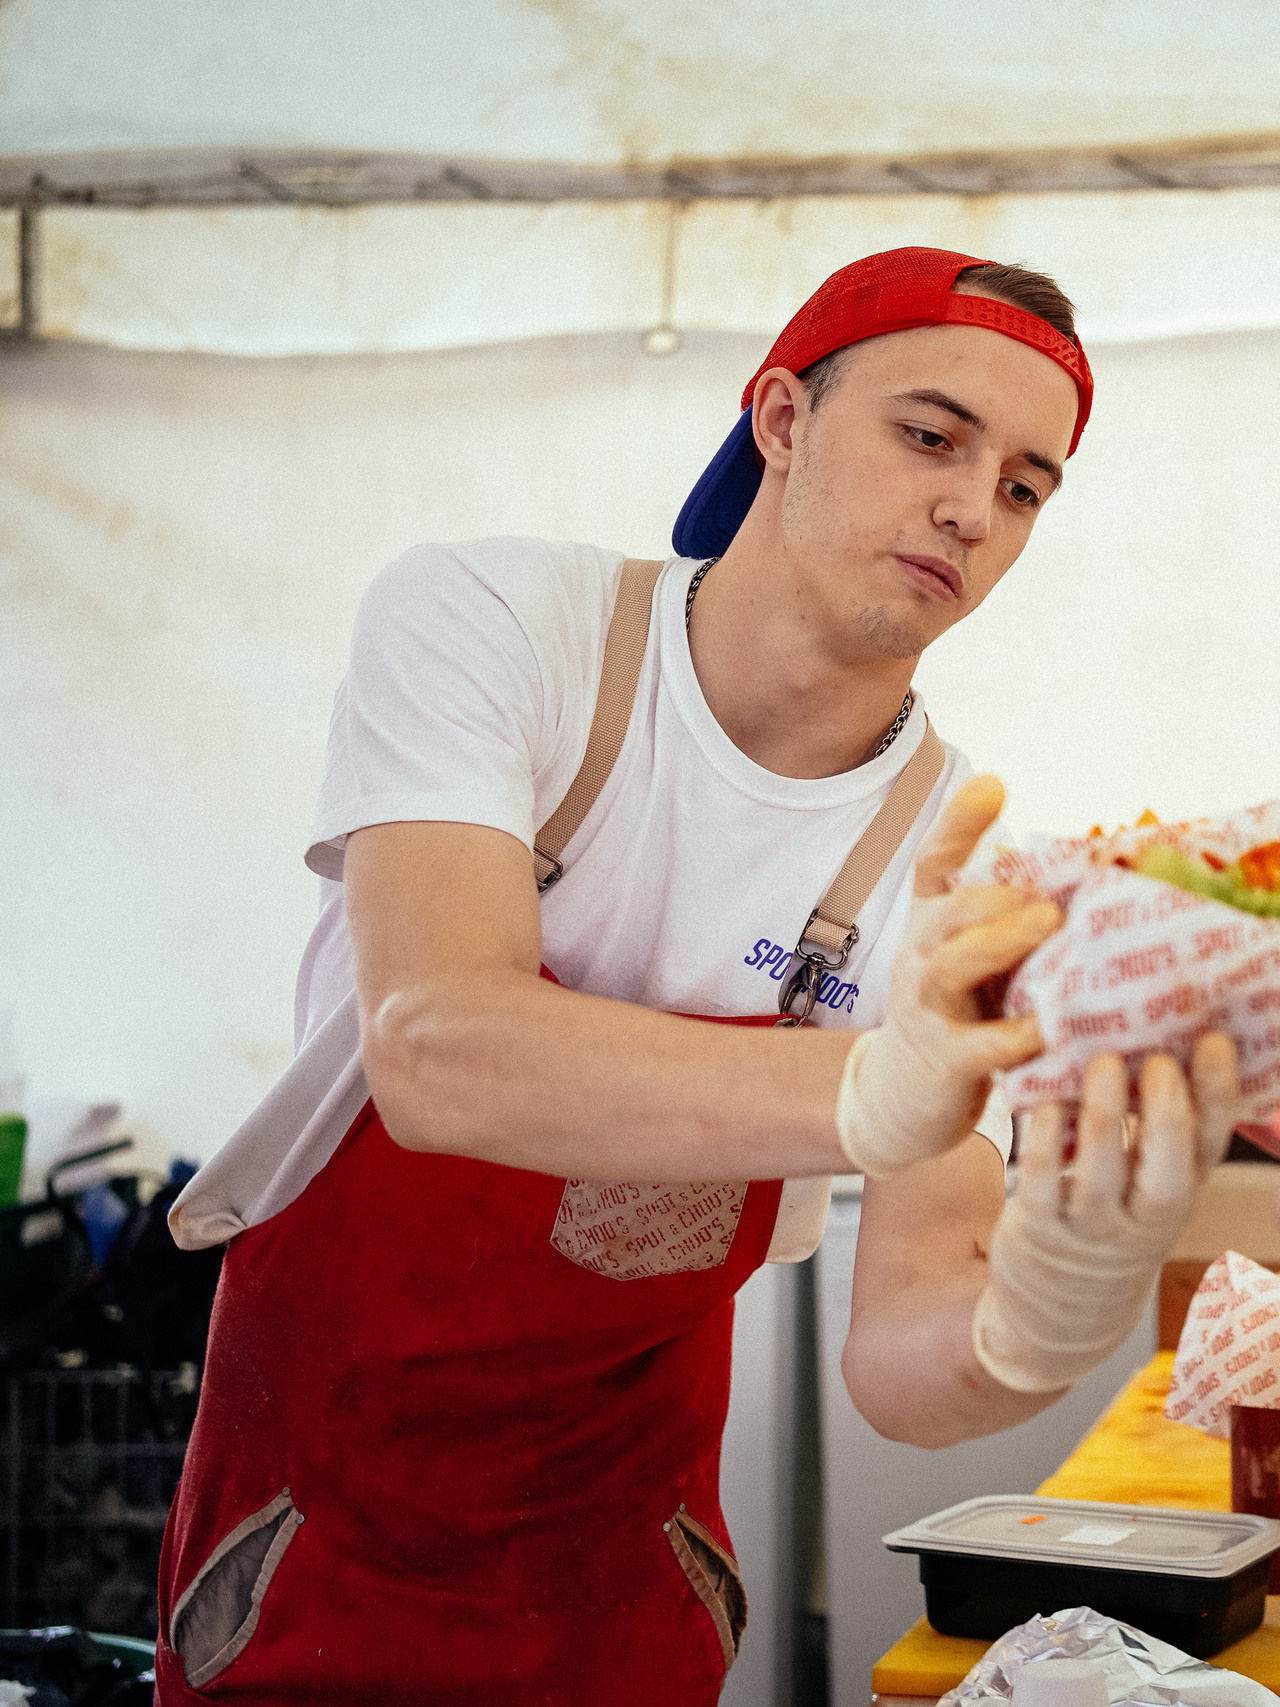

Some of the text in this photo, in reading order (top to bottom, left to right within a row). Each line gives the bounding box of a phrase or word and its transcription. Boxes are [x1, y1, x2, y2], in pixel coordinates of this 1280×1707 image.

[744, 938, 859, 1013] SPO OO'S
[677, 1183, 736, 1229] CHOO'S
